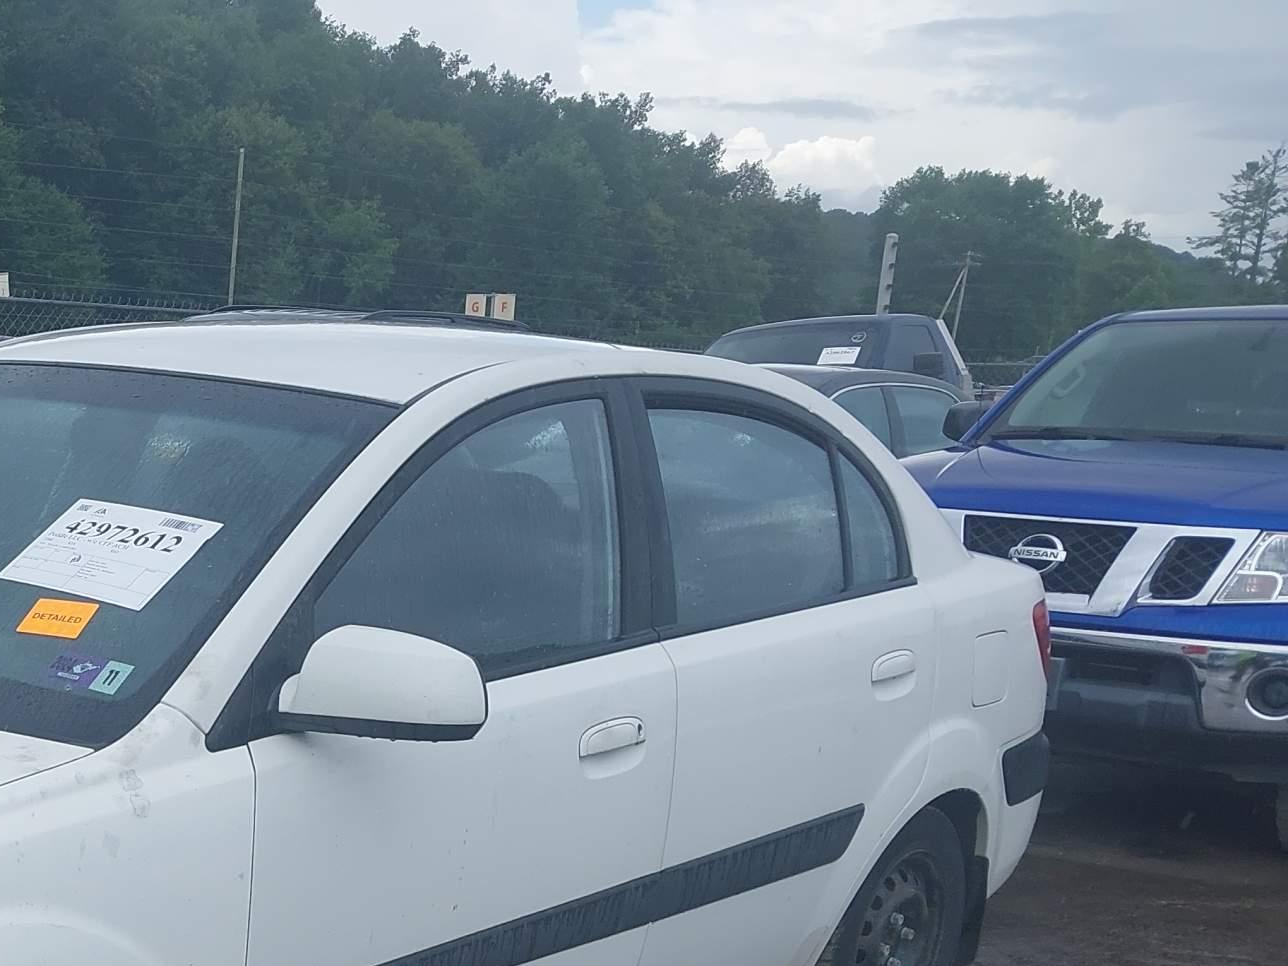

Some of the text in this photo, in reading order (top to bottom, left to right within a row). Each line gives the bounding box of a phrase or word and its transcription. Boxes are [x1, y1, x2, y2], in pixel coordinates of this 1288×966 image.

[472, 302, 480, 312] G
[501, 301, 508, 312] F
[65, 518, 183, 553] 42972612
[1013, 549, 1059, 559] NISSAN
[32, 612, 82, 624] DETAILED
[102, 669, 120, 686] 11
